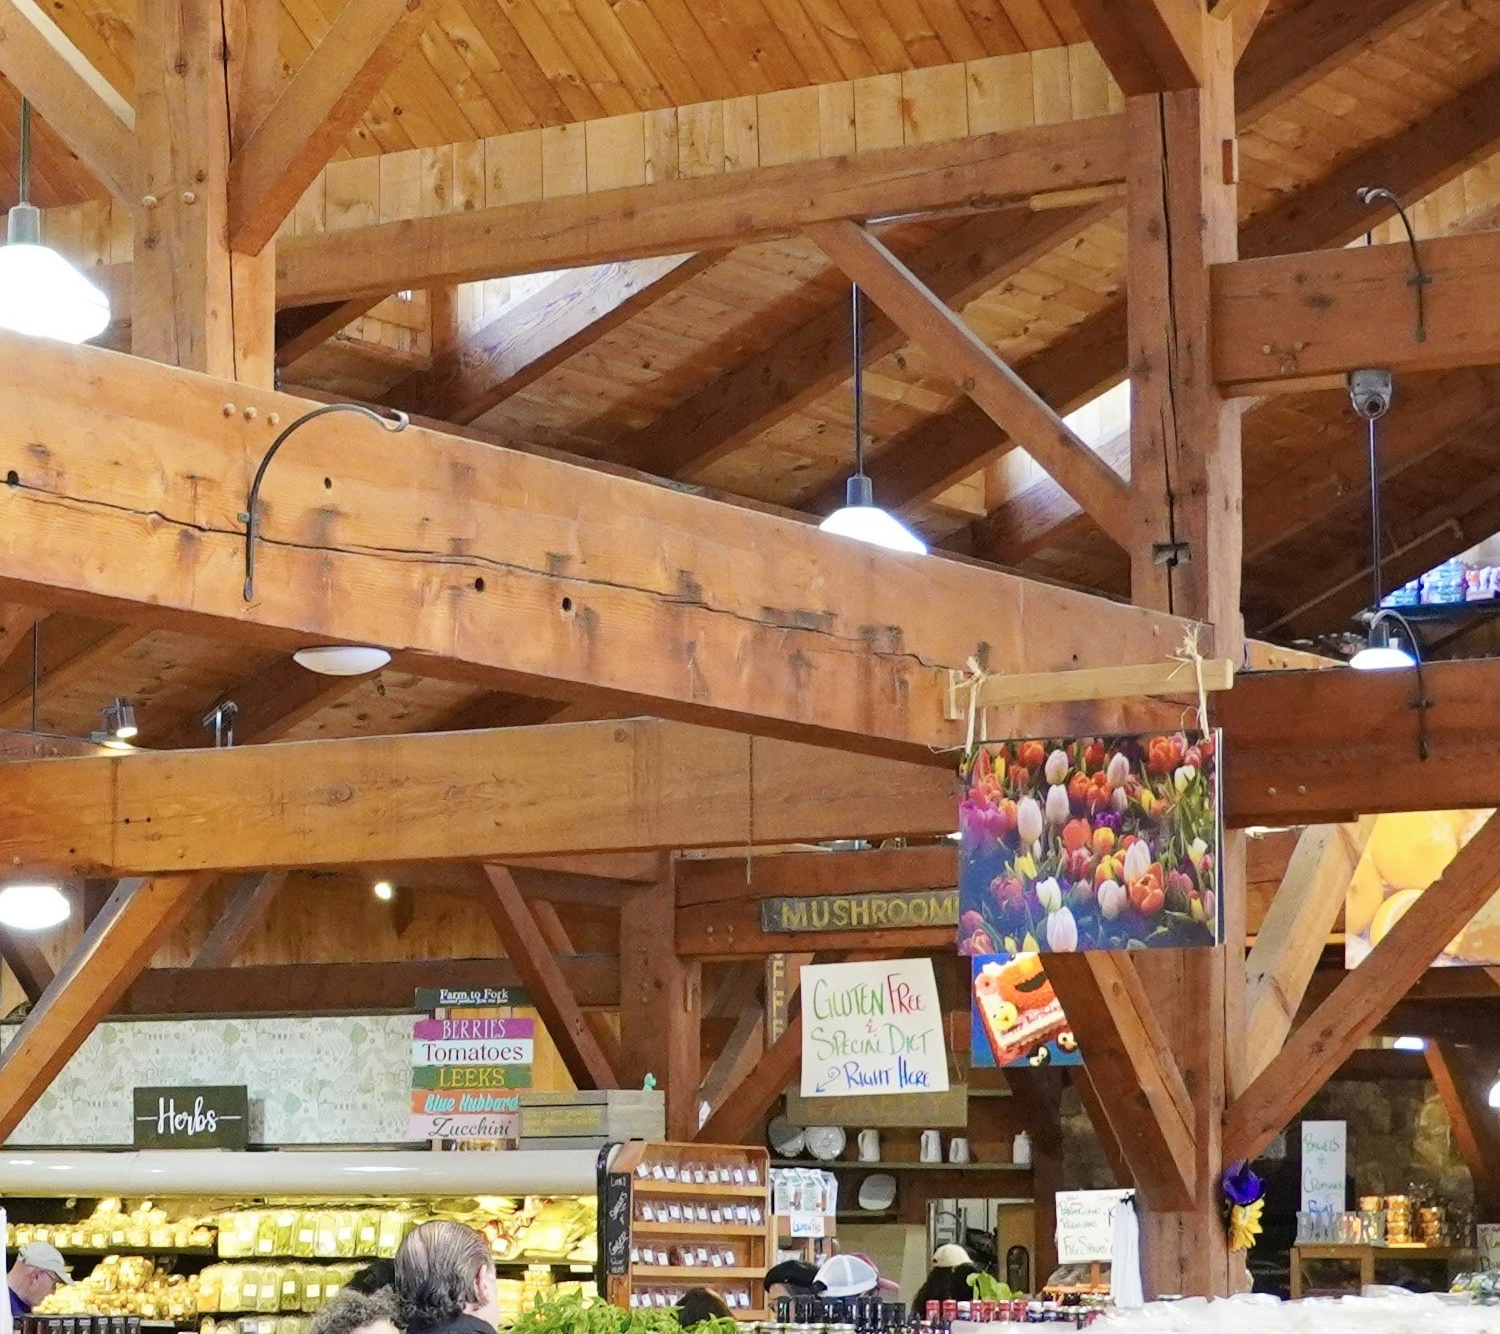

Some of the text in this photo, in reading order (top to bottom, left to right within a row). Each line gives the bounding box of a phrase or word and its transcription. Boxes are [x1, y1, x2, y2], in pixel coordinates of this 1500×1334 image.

[781, 898, 959, 928] MUSHROOM
[440, 988, 469, 1002] Farm
[484, 988, 509, 1003] Fork
[812, 978, 886, 1021] GLUTEN
[887, 973, 926, 1015] FREE
[443, 1019, 506, 1039] BERRIES
[810, 1022, 935, 1061] SPECIAL DIET
[422, 1043, 524, 1062] Tomatoes
[438, 1068, 505, 1087] LEEKS
[843, 1055, 931, 1089] RIGHT HERE
[424, 1093, 519, 1112] Blue Hubbard
[156, 1096, 219, 1137] Herbs
[428, 1117, 512, 1138] Zucchini
